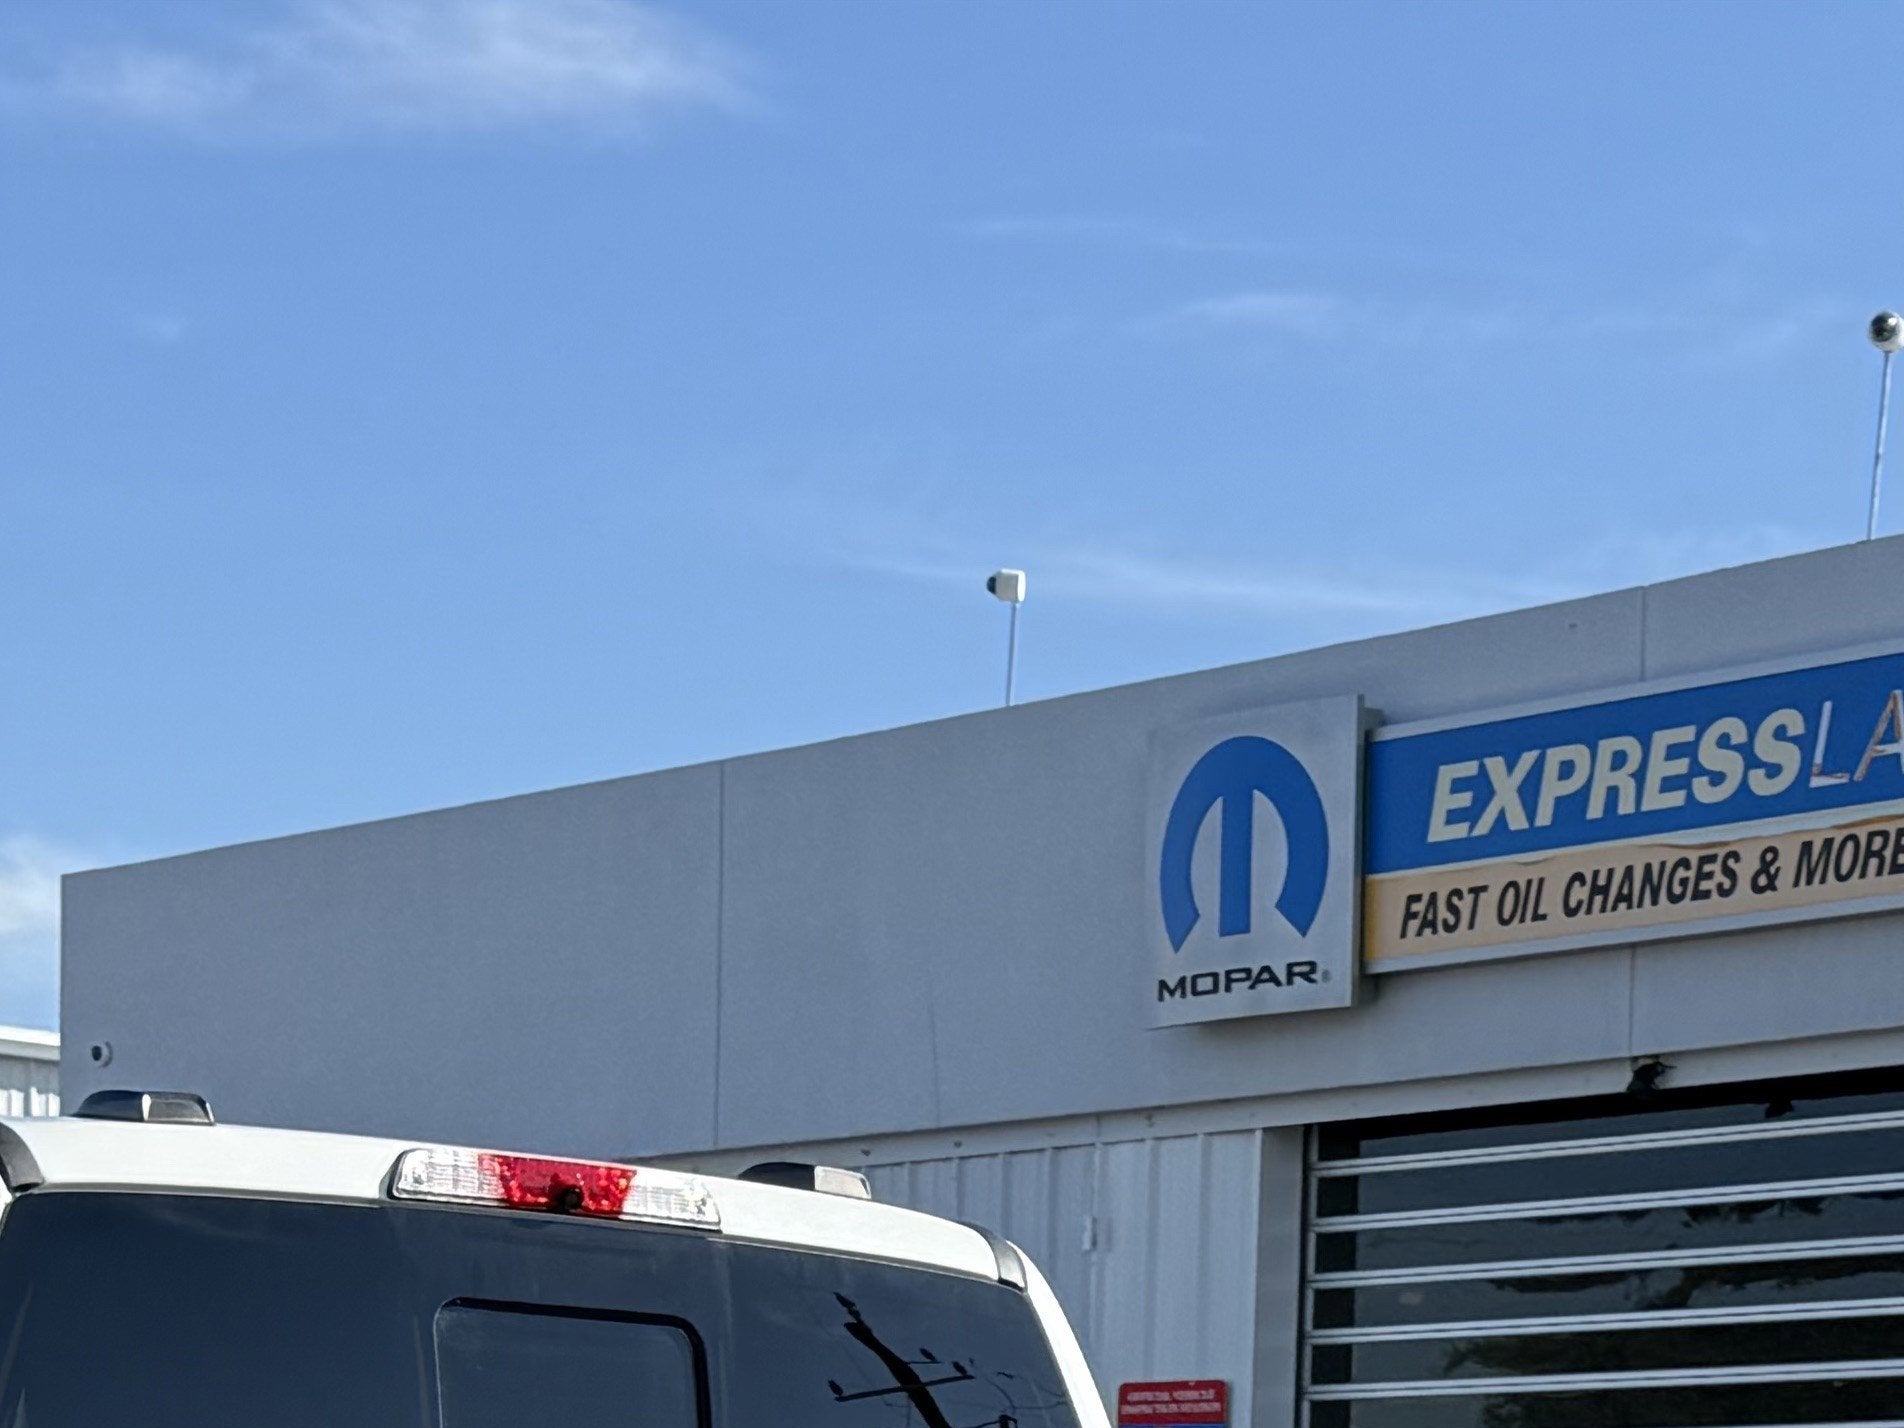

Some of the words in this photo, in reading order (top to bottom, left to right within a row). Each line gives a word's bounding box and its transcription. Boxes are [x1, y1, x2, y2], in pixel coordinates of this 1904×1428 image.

[1398, 883, 1490, 940] FAST
[1495, 872, 1548, 928] OIL
[1560, 848, 1742, 915] CHANGES
[1750, 844, 1781, 891] &
[1157, 960, 1318, 1002] MOPAR
